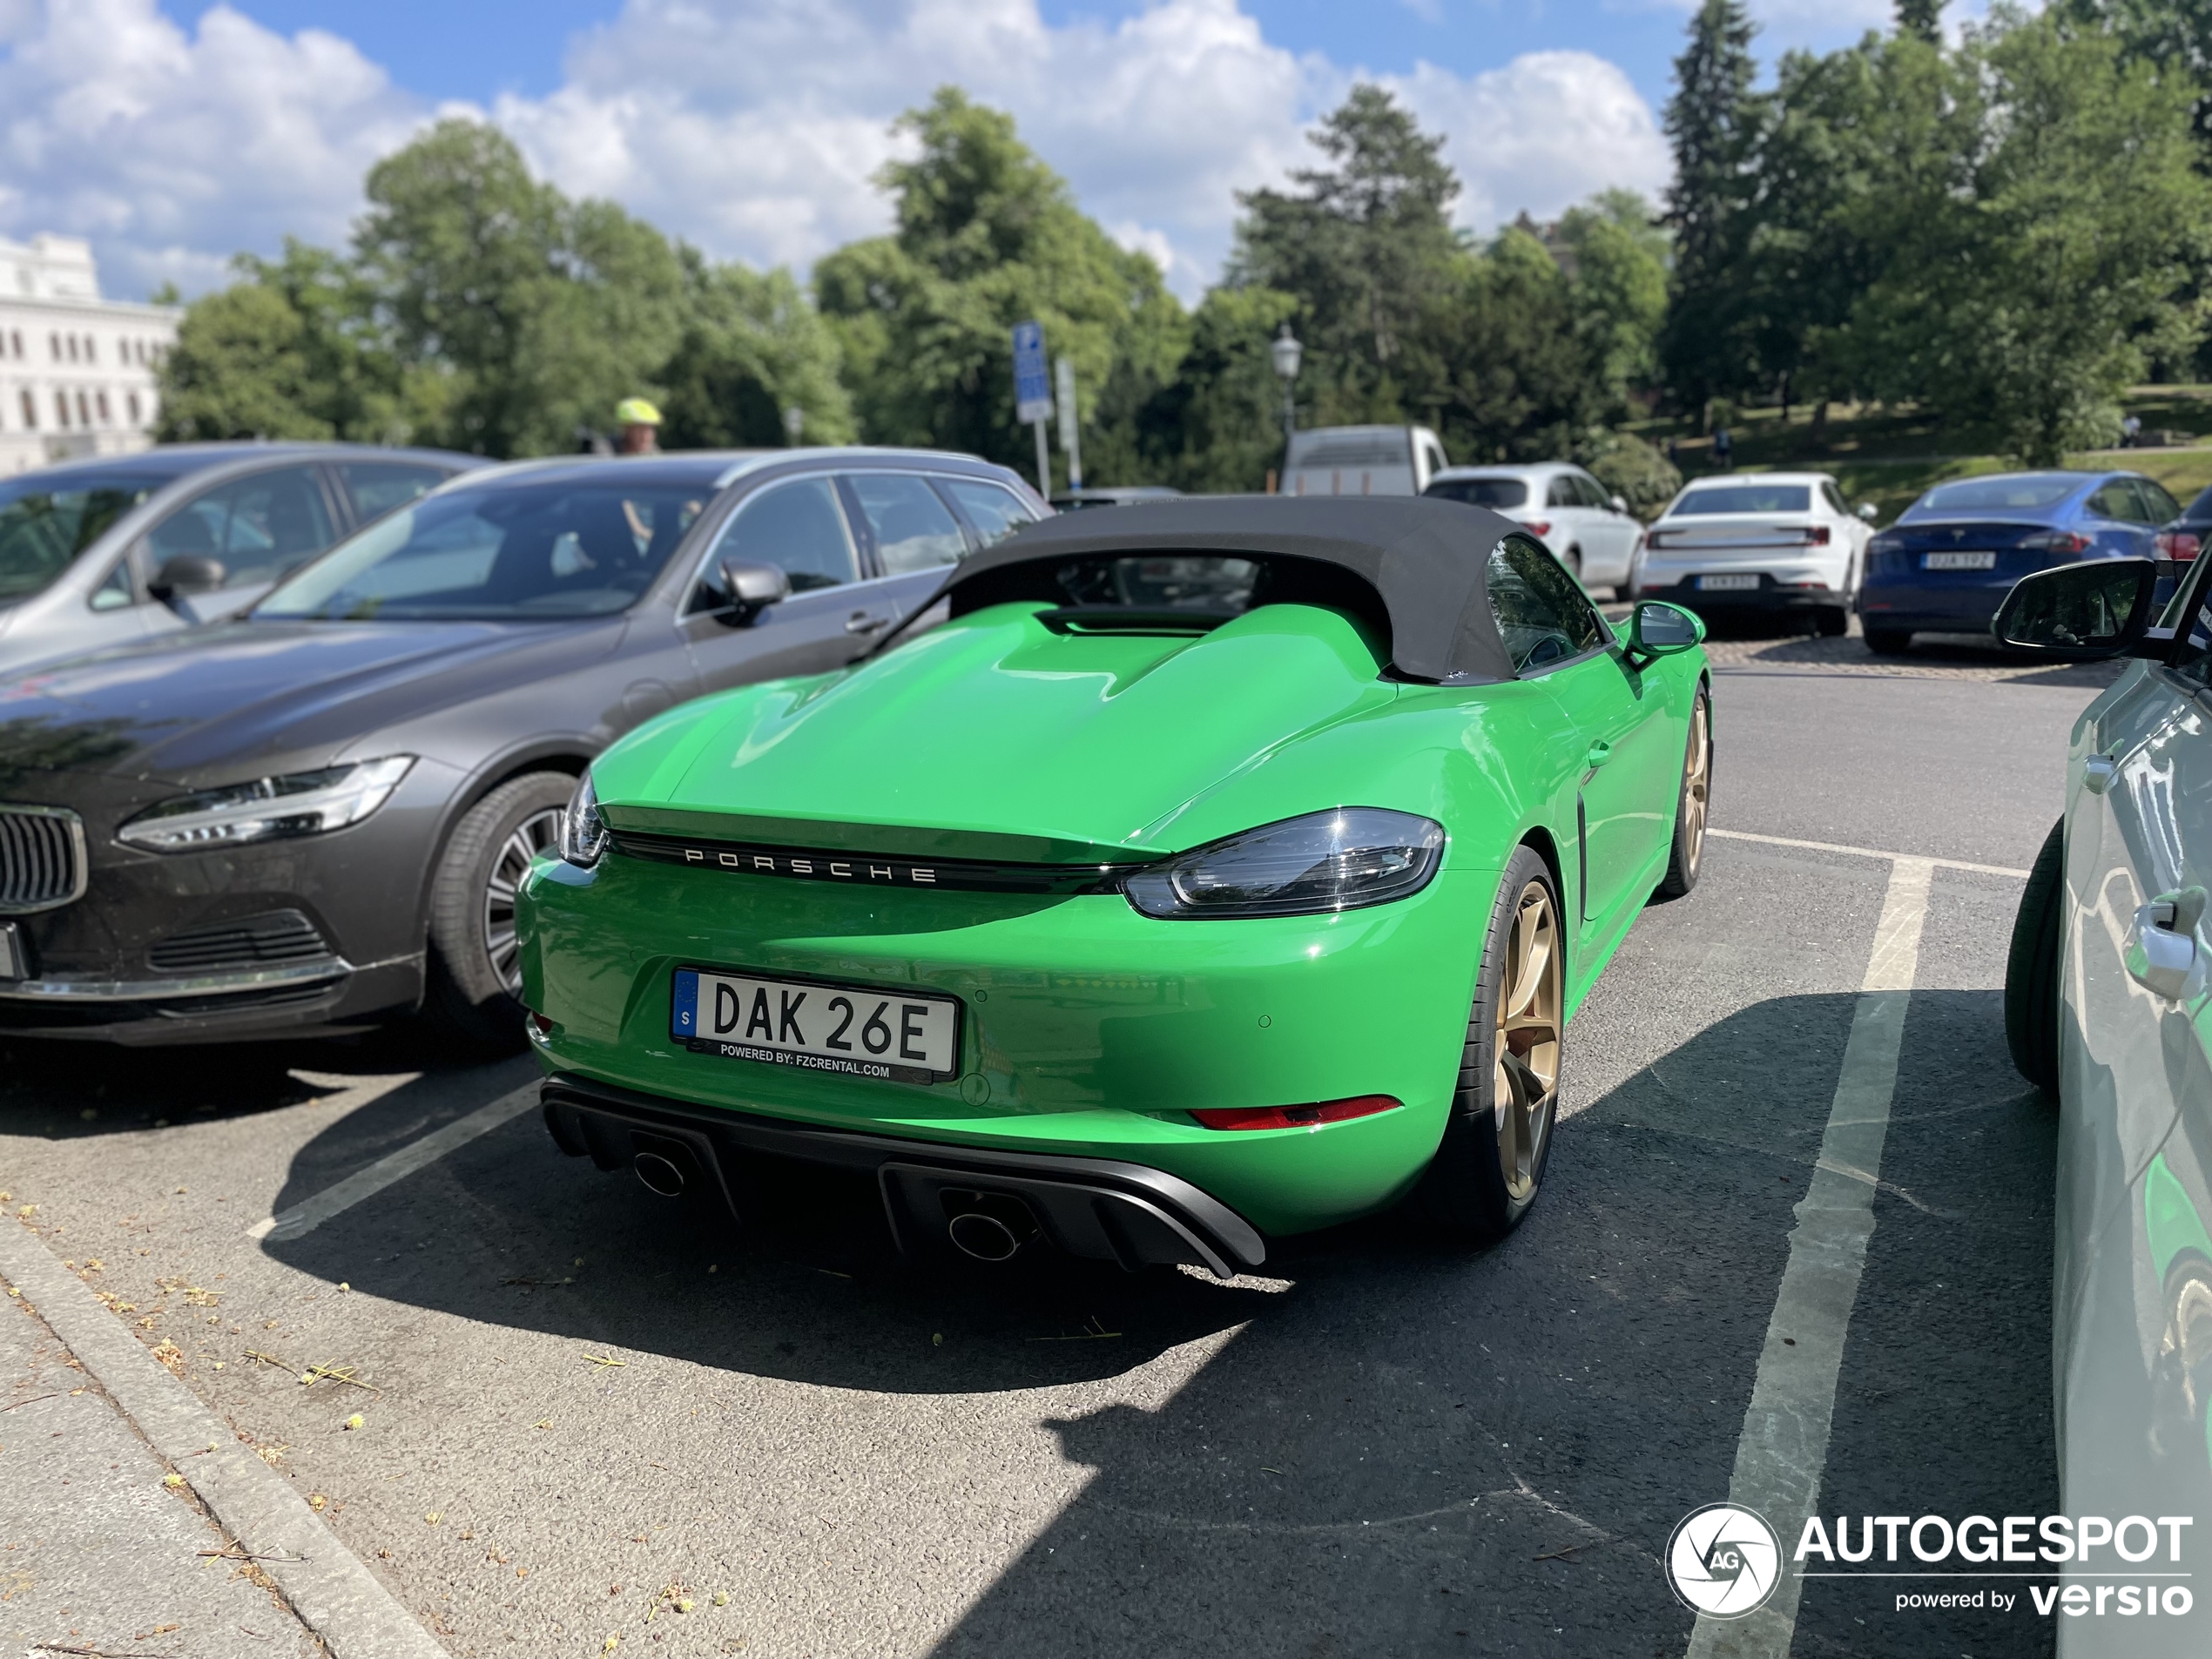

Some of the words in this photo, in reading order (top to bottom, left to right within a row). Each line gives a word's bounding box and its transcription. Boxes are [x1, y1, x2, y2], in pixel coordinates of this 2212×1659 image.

[685, 849, 936, 882] PORSCHE
[681, 1011, 690, 1025] S
[714, 981, 807, 1045] DAK
[826, 996, 928, 1062] 26E
[720, 1044, 774, 1062] POWERED
[776, 1052, 794, 1065] BY:
[796, 1055, 890, 1078] FZCRENTAL.COM
